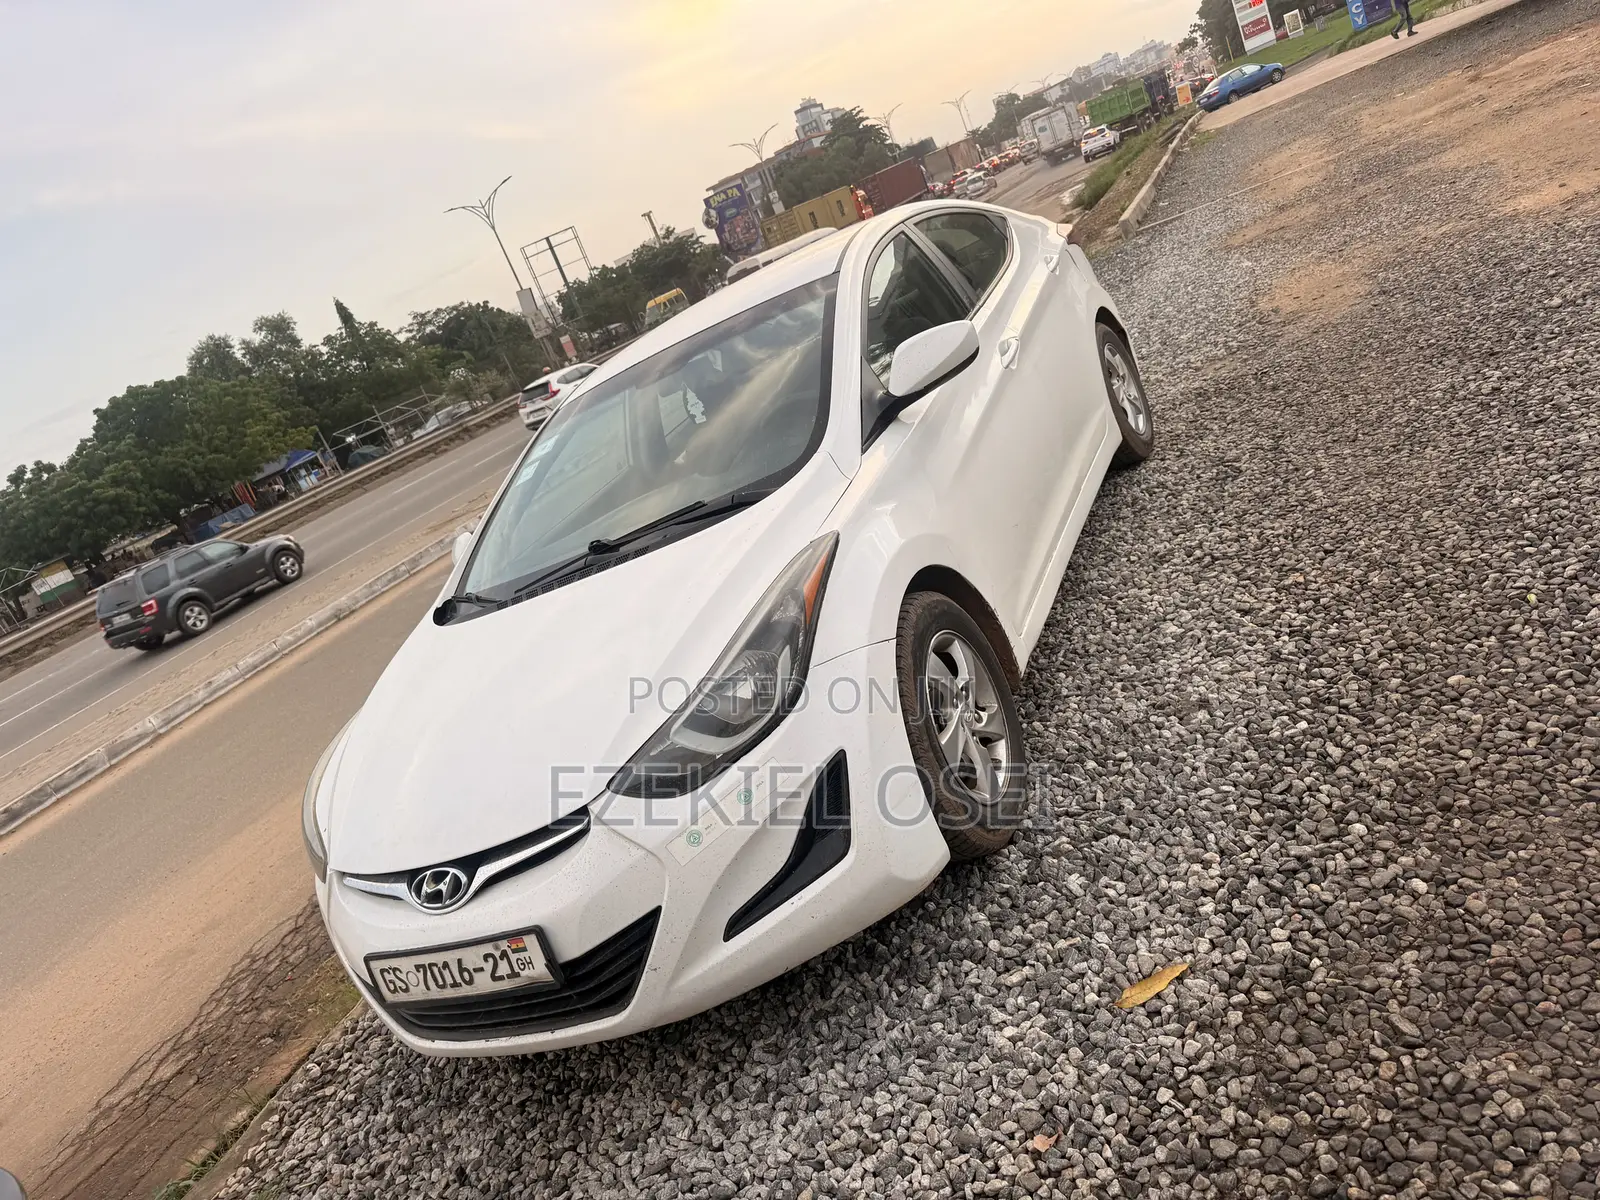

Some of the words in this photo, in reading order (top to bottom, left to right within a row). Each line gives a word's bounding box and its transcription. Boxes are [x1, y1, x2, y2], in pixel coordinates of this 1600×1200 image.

[1349, 0, 1364, 25] CY
[379, 967, 410, 994] GS
[414, 949, 521, 991] 7016-21
[515, 955, 535, 972] GH
